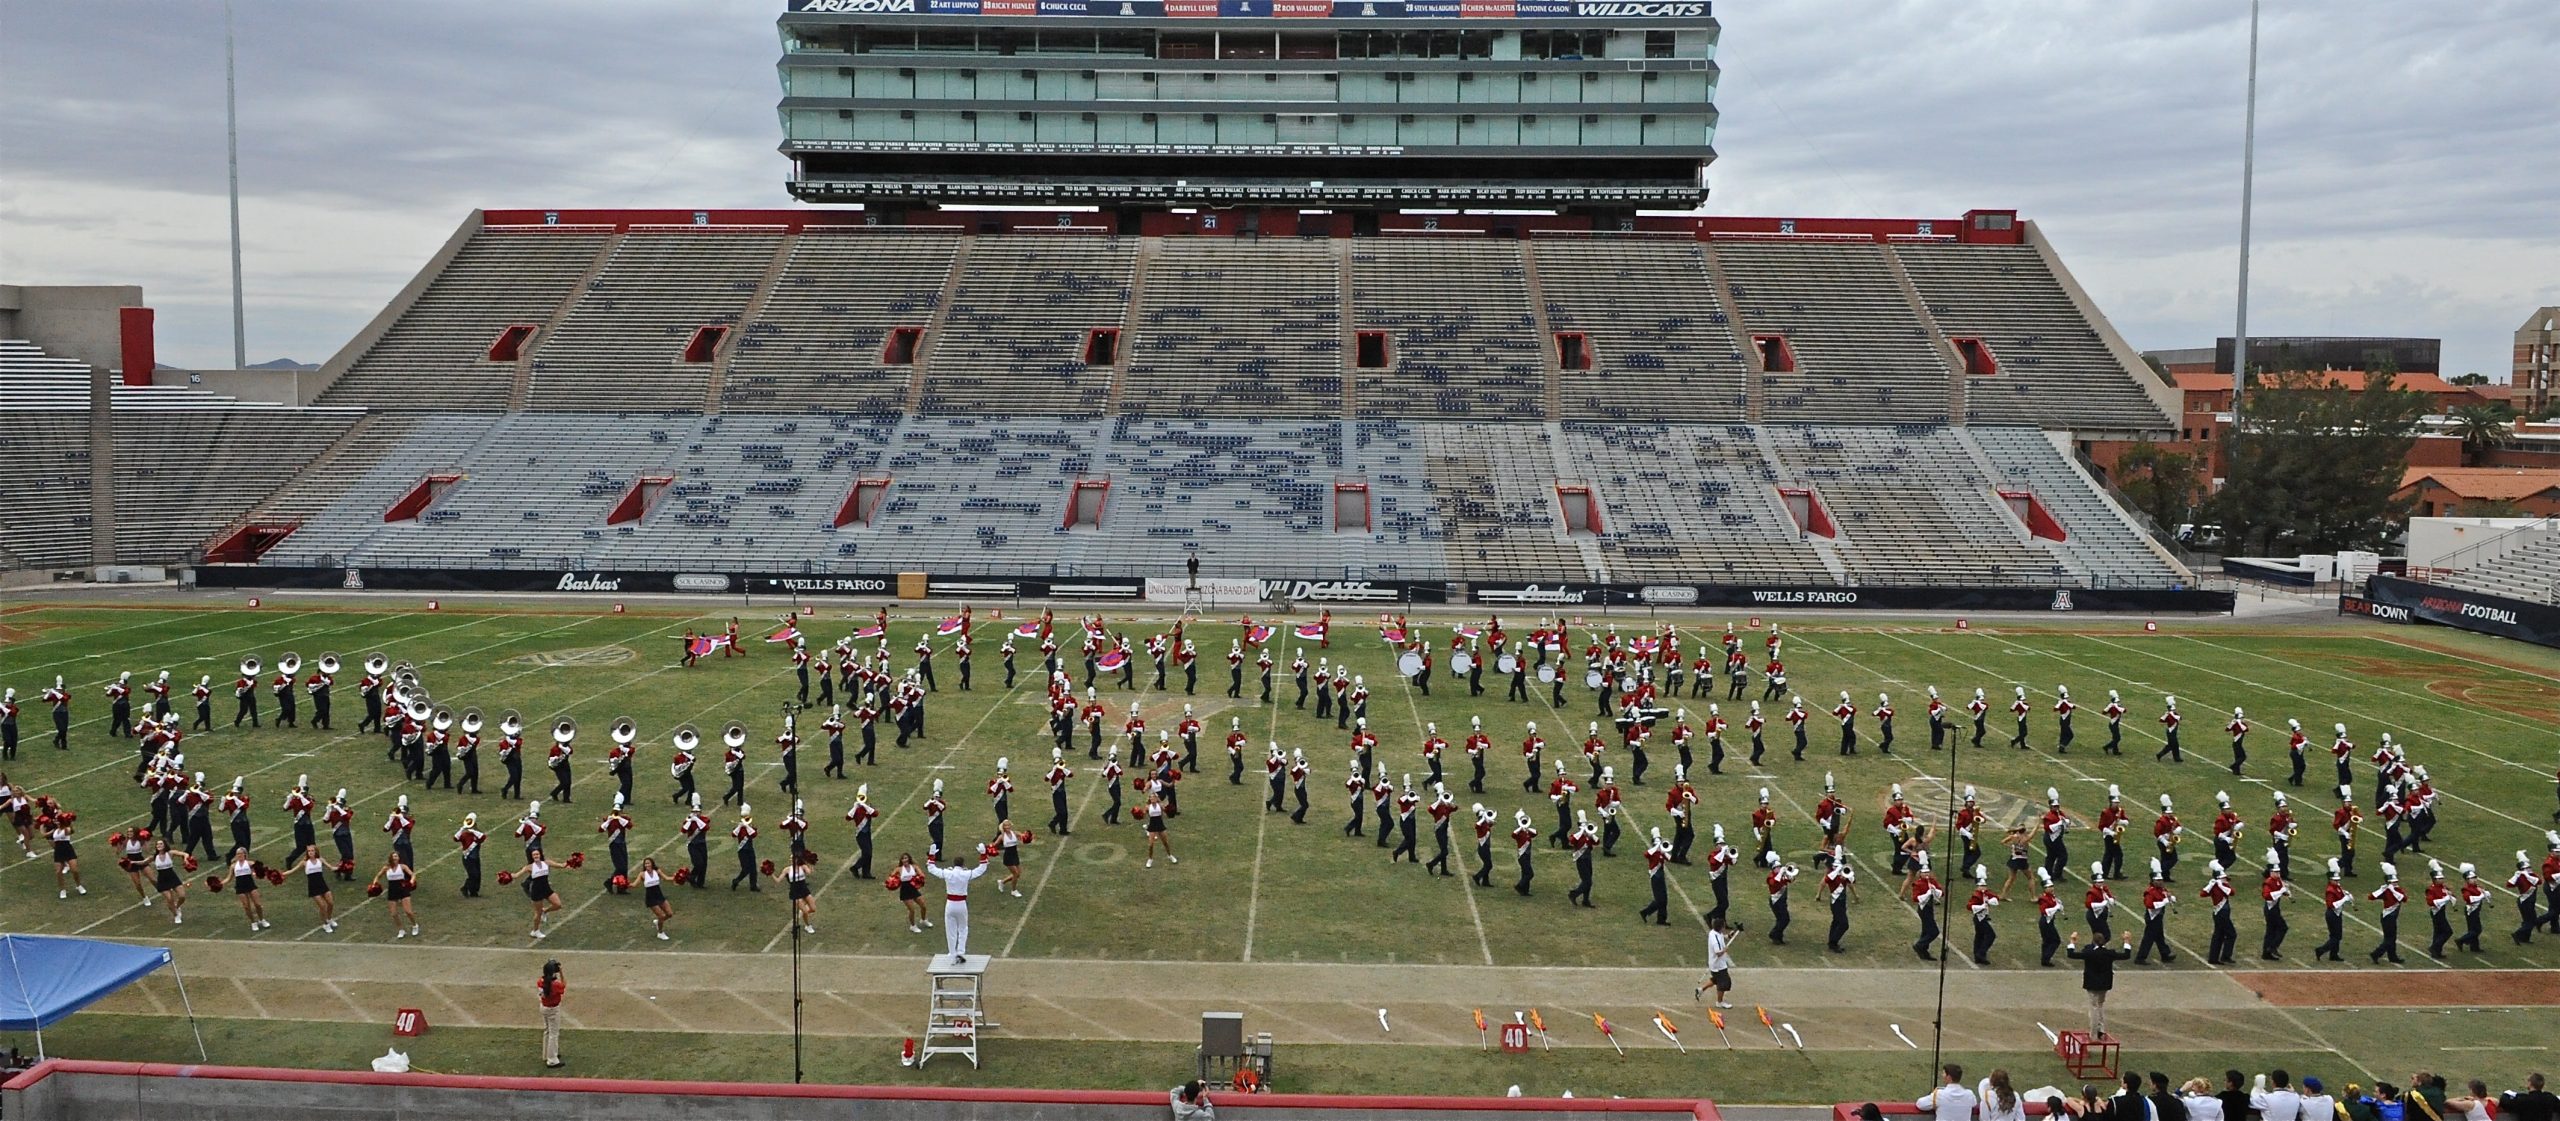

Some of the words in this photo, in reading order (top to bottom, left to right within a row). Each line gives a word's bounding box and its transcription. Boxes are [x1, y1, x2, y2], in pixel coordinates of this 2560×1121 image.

[801, 0, 915, 12] ARIZONA
[1578, 3, 1704, 16] WILDCATS
[547, 217, 557, 225] 17
[696, 217, 706, 225] 18
[1058, 218, 1071, 227] 20
[1205, 219, 1215, 228] 21
[1425, 221, 1437, 230] 22
[1781, 225, 1794, 233] 24
[191, 374, 201, 384] 16
[557, 572, 621, 591] Bashas'
[782, 579, 834, 590] WELLS
[836, 579, 886, 590] FARGO
[1148, 585, 1182, 594] UNIVERSITY
[1223, 586, 1241, 595] BAND
[1243, 586, 1257, 595] DAY
[1752, 591, 1804, 602] WELLS
[1806, 592, 1857, 603] FARGO
[2461, 603, 2517, 625] FOOTBALL
[398, 1012, 416, 1033] 40
[1504, 1028, 1523, 1048] 40
